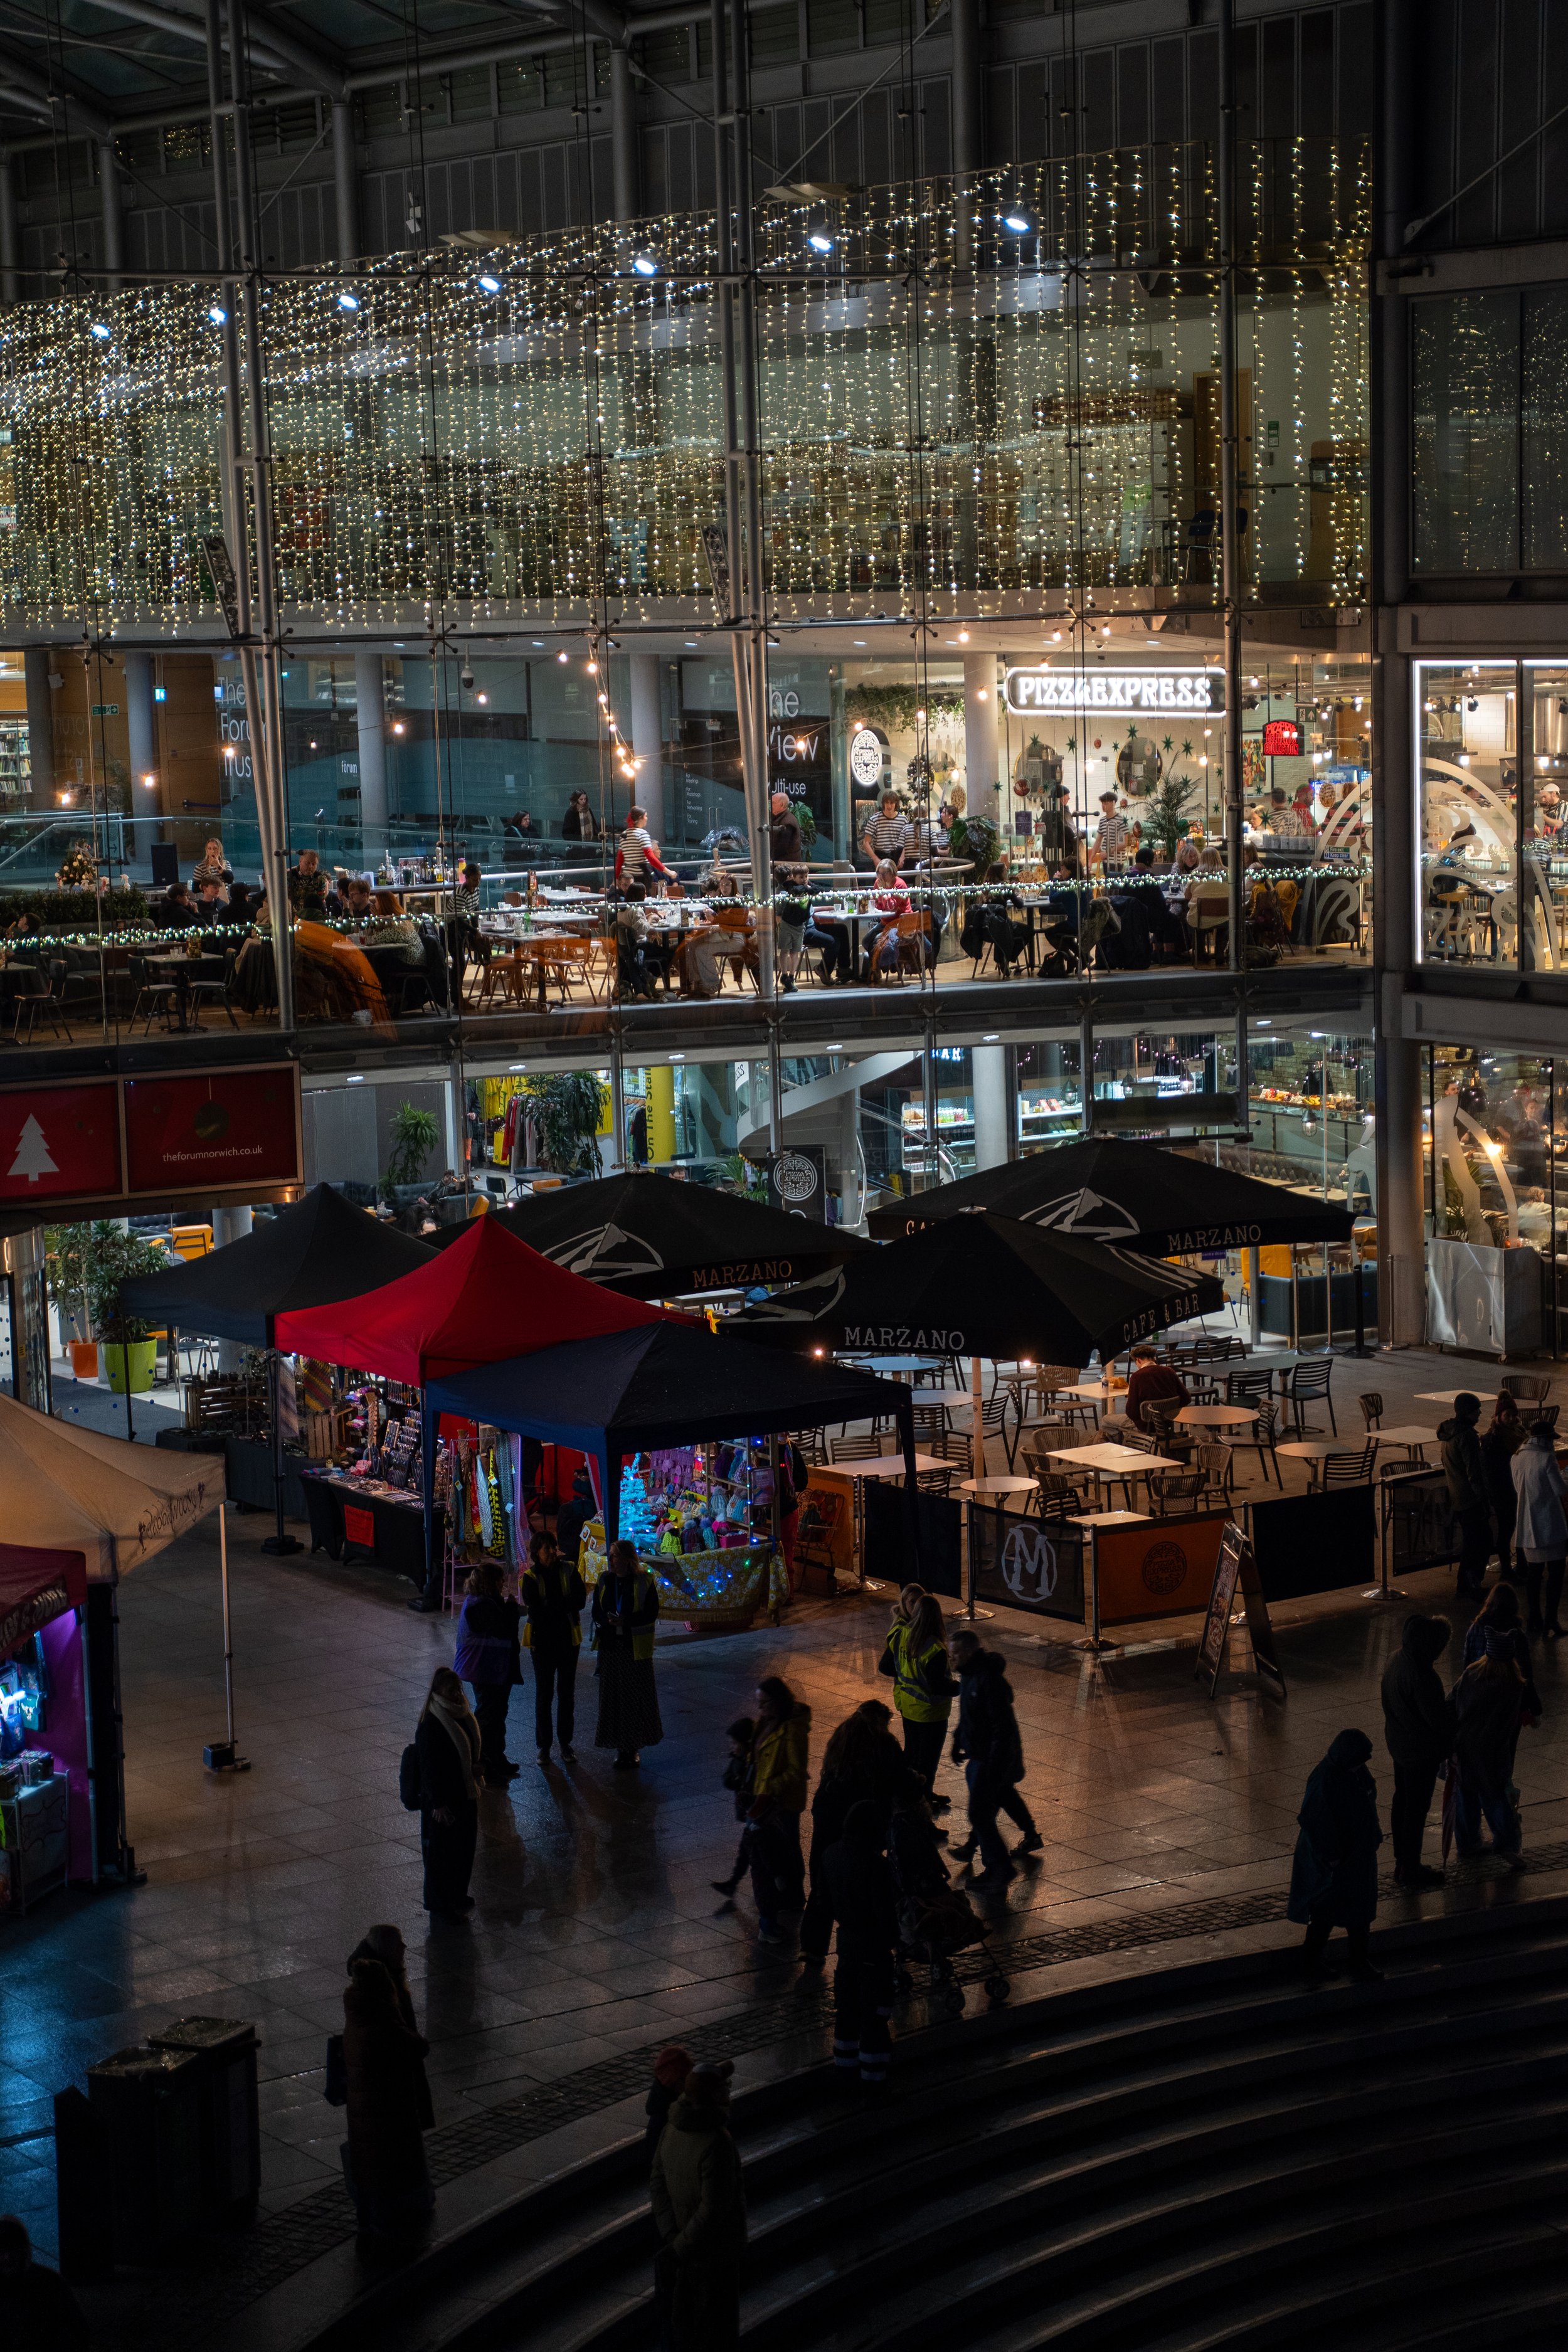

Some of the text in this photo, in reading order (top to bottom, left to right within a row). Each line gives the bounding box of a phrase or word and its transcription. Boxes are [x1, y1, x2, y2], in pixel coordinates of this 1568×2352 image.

[768, 682, 800, 718] he
[855, 755, 879, 763] EXPRESS
[1264, 743, 1299, 755] COLLECTION
[645, 1105, 654, 1130] The
[162, 1144, 263, 1162] theforumnorwich.co.uk
[646, 1137, 654, 1160] On
[1167, 1224, 1262, 1252] MARZANO
[692, 1259, 793, 1288] MARZANO
[1123, 1310, 1155, 1343] CAFE
[1175, 1293, 1200, 1318] BAR
[844, 1327, 965, 1350] MARZANO
